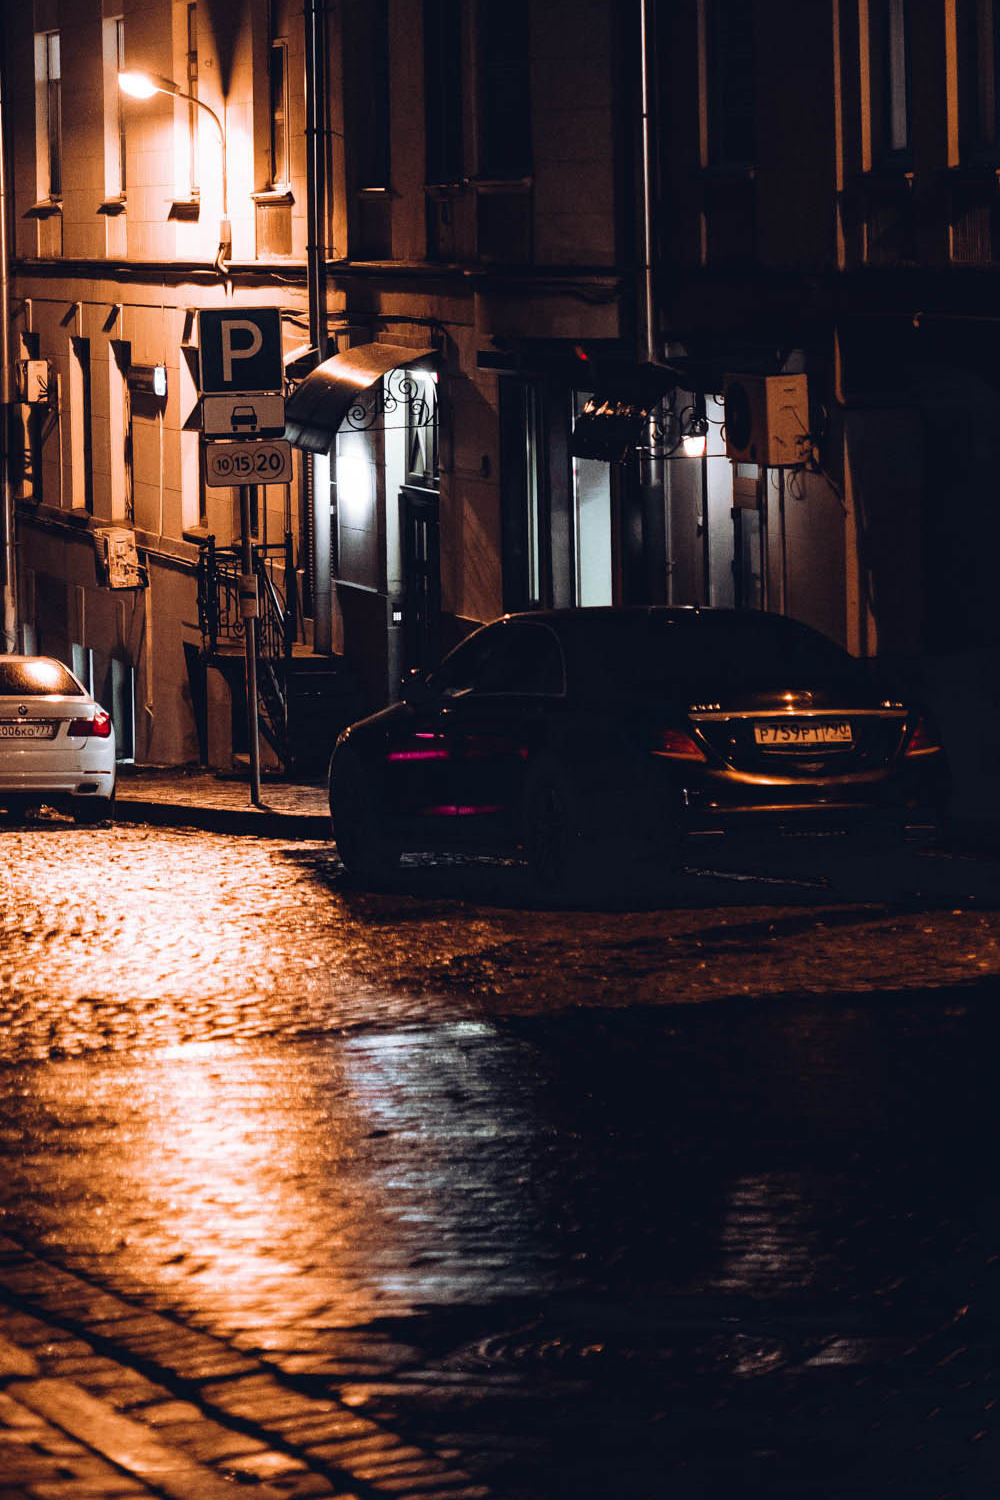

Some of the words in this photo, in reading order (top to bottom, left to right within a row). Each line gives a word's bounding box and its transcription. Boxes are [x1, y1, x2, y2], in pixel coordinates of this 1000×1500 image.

[221, 319, 263, 382] P
[217, 458, 229, 470] 10
[234, 456, 250, 470] 15
[257, 453, 280, 470] 20
